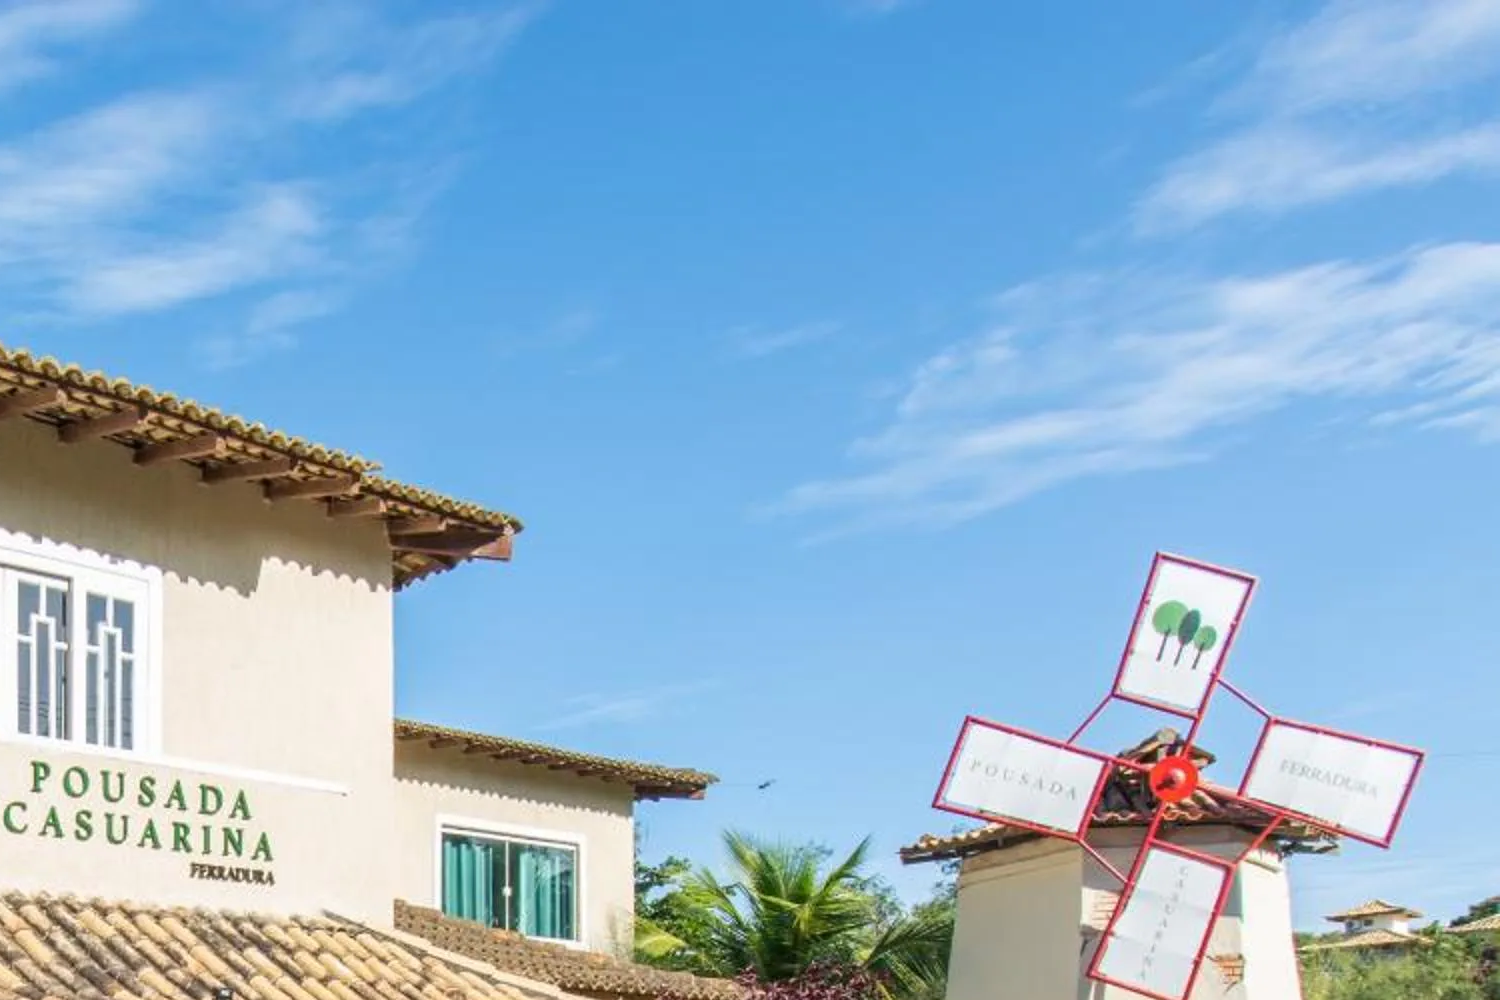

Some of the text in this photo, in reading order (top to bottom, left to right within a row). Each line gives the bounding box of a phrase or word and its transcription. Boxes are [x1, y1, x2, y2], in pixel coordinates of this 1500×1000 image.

[30, 760, 252, 821] POUSADA
[969, 758, 1077, 801] POUSADA
[1280, 758, 1379, 799] FERRADURA
[3, 801, 275, 862] CASUARINA
[189, 862, 275, 886] FERRADURA
